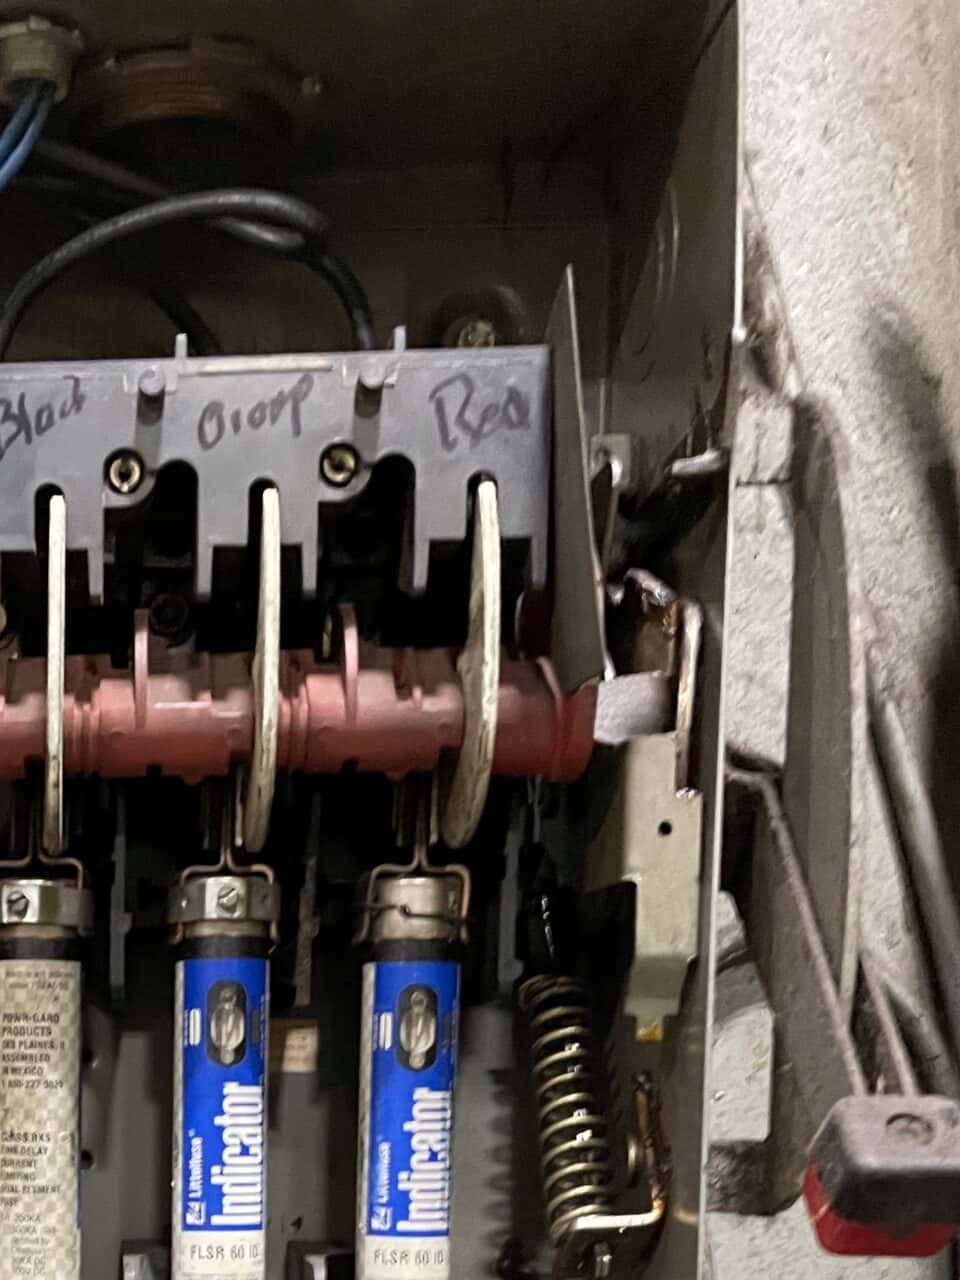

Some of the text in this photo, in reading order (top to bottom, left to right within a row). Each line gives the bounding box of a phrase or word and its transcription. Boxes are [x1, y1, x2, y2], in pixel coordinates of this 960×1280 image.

[209, 1080, 264, 1227] Indicator
[395, 1086, 452, 1233] Indicator
[190, 1244, 225, 1260] FLSR
